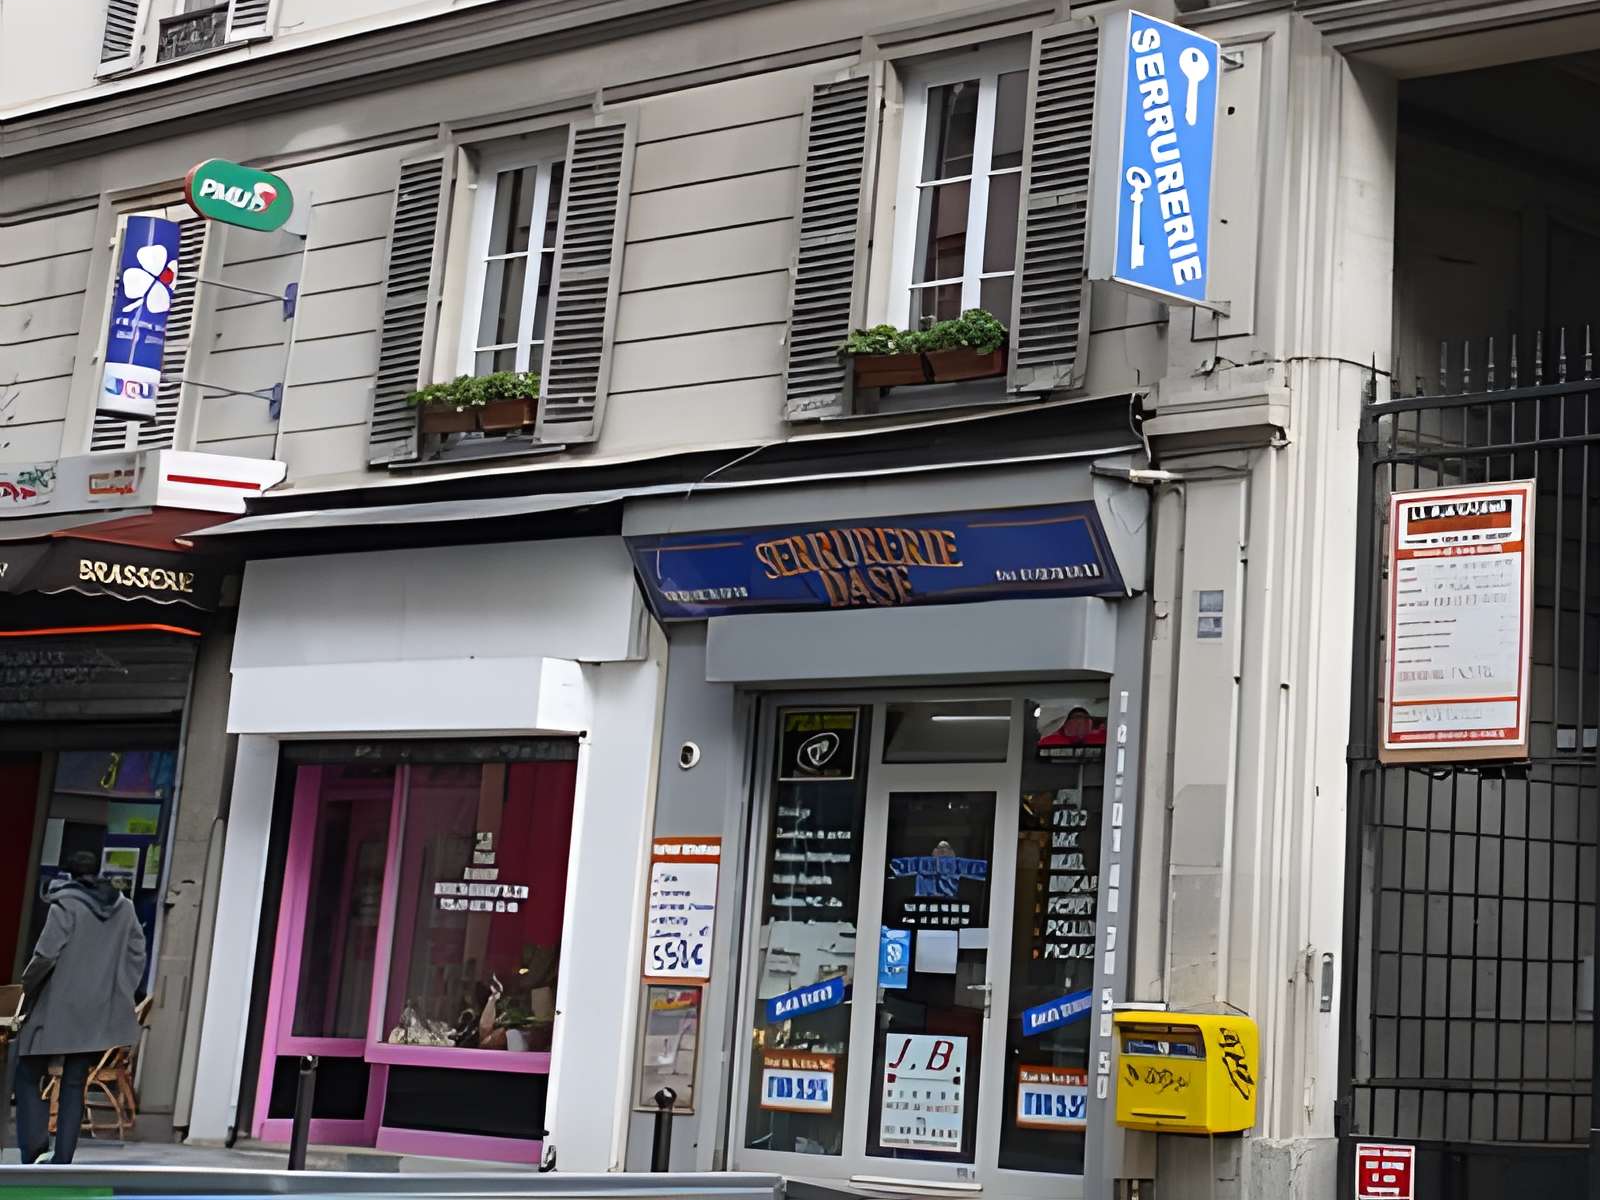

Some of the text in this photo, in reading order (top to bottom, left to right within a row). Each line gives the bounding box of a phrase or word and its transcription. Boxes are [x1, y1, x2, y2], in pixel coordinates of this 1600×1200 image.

[1130, 27, 1203, 286] SERRURERIE
[199, 178, 252, 210] PMU
[754, 527, 964, 580] SERRURERIE
